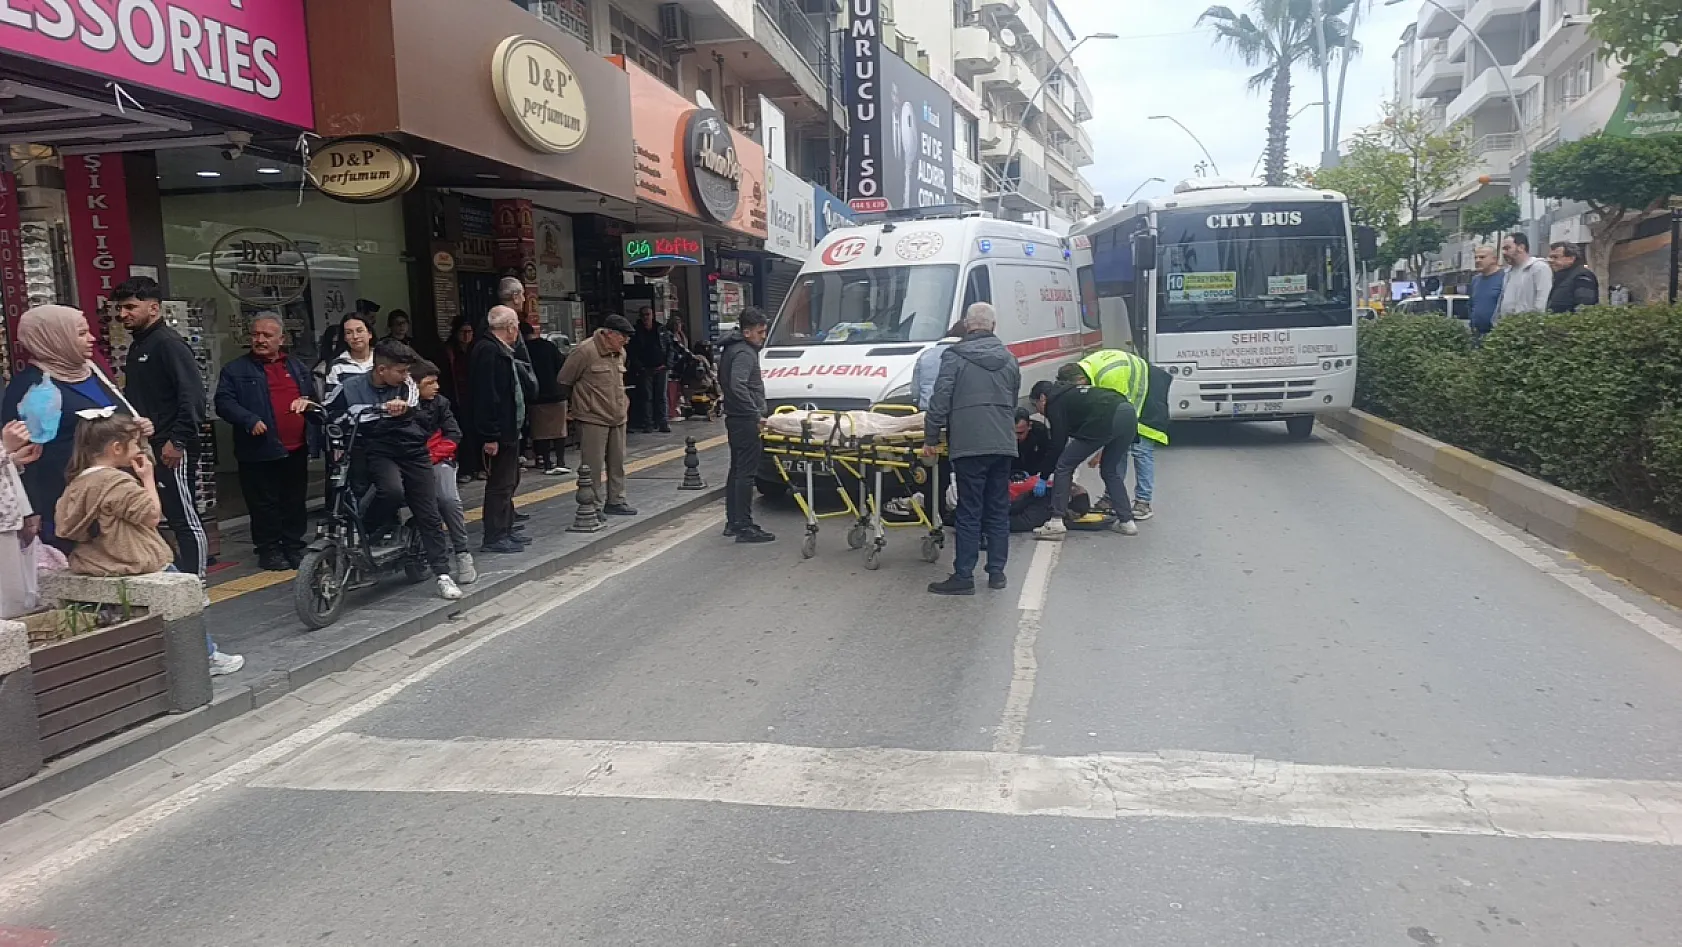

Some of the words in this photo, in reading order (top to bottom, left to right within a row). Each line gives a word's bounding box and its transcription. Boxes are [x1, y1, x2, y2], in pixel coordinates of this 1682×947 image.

[521, 97, 581, 132] perfumum
[321, 170, 391, 186] perfumum
[1206, 213, 1255, 229] CITY
[1260, 211, 1302, 226] BUS
[834, 242, 867, 258] 112
[1170, 275, 1183, 289] 10
[1231, 330, 1271, 345] ŞEHİR
[1177, 348, 1209, 358] ANTALYA
